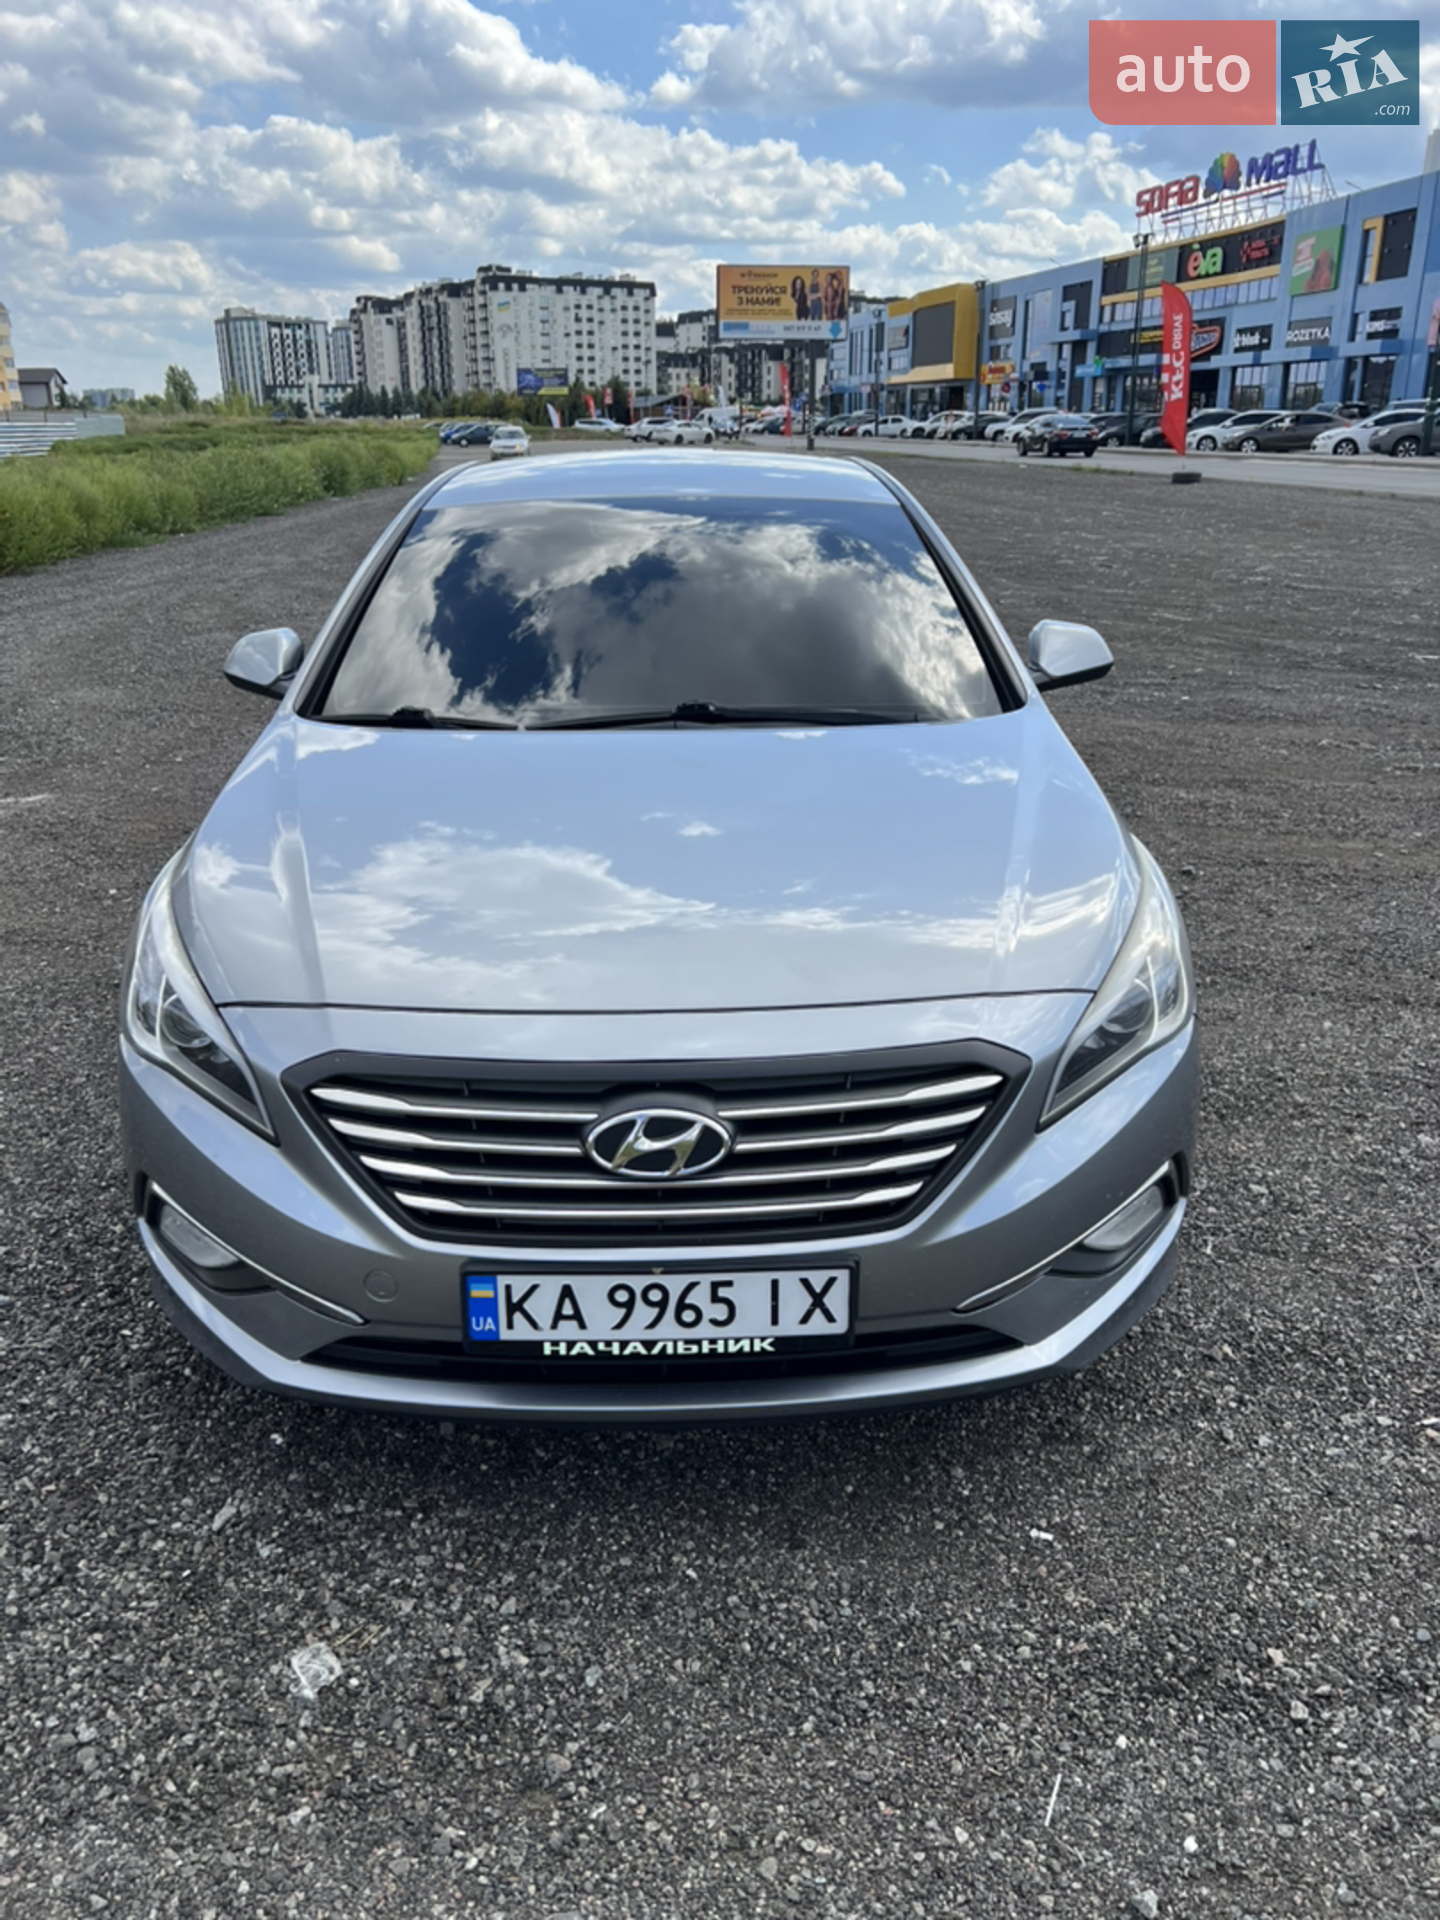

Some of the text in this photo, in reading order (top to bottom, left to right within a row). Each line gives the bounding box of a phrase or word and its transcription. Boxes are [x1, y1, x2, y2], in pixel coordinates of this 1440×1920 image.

[731, 282, 788, 296] ТРЕНУЙСЯ
[1284, 326, 1331, 342] ROZETKA
[471, 1275, 839, 1332] UA KA 9965 IX
[543, 1336, 776, 1356] НАЧАЛЬНИК
